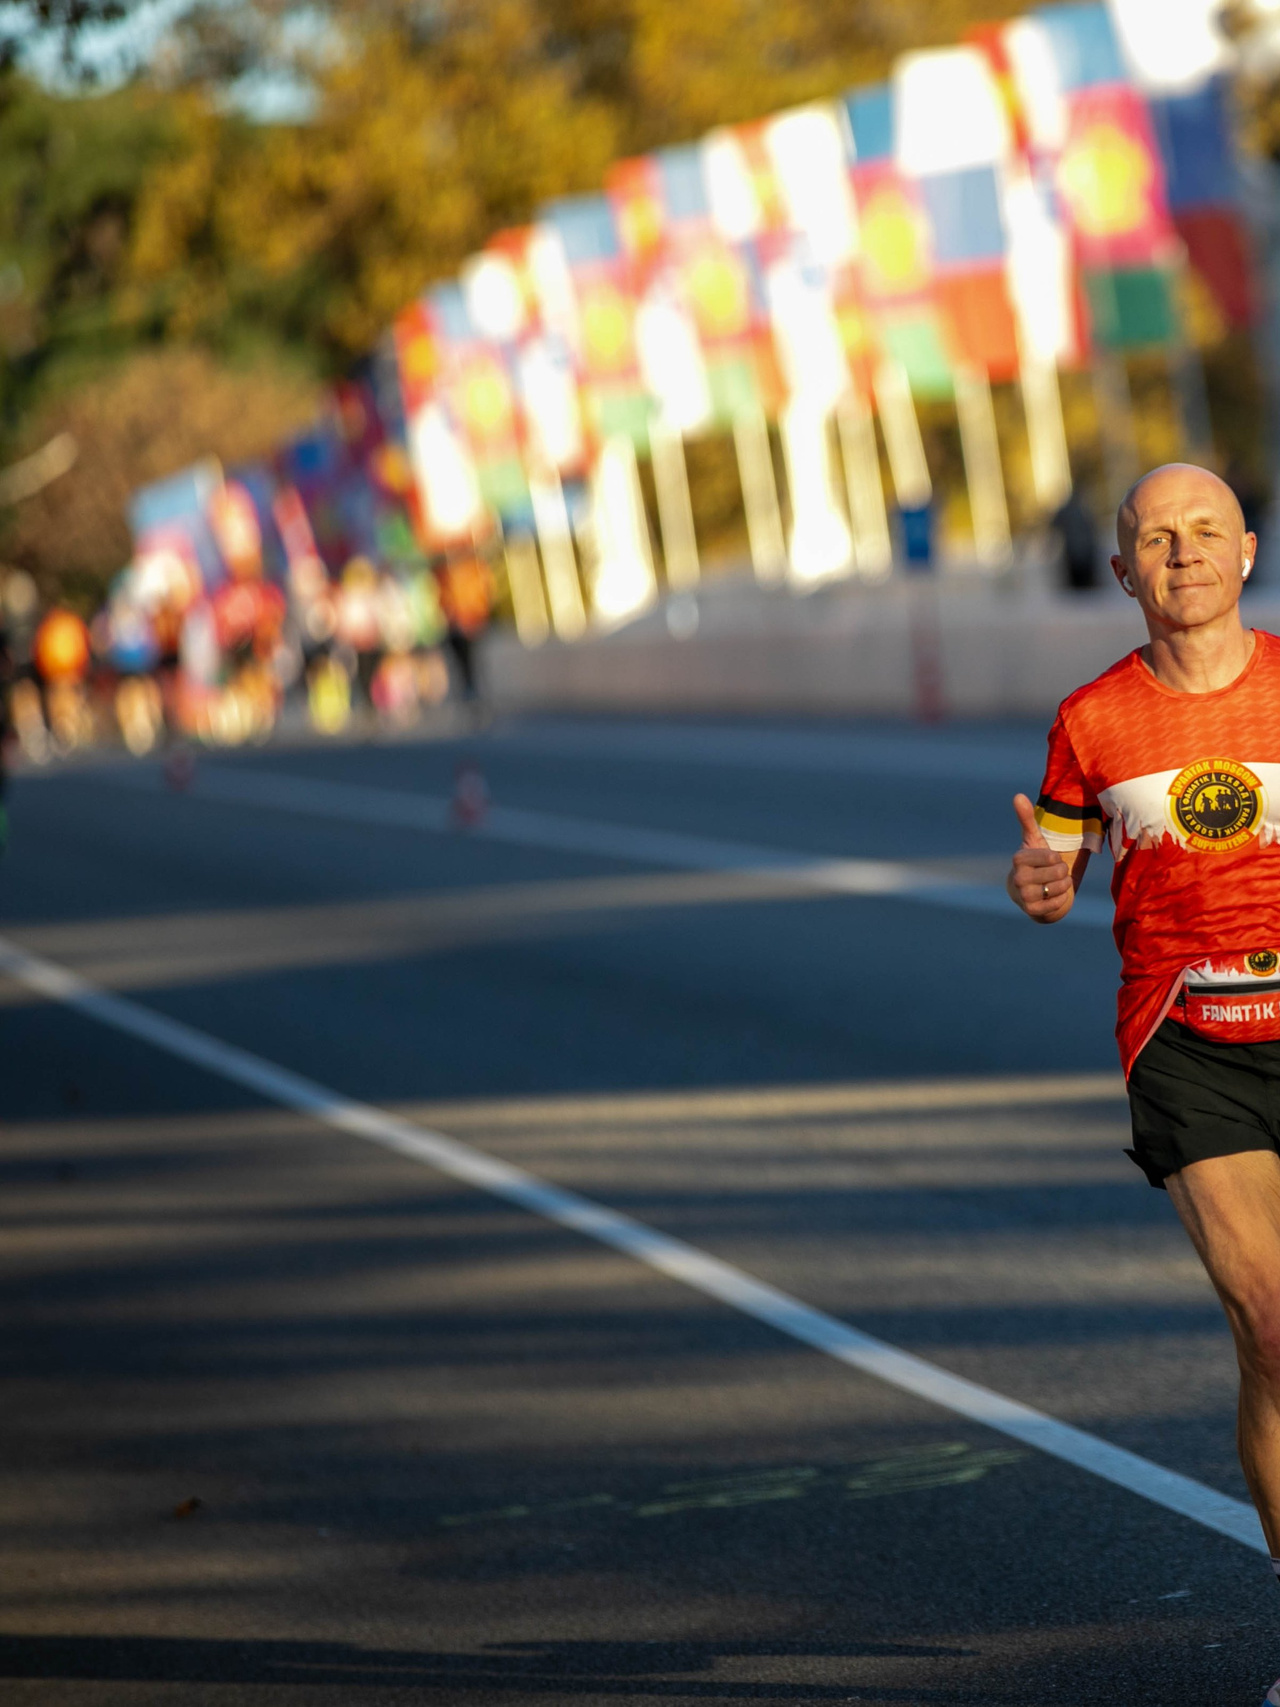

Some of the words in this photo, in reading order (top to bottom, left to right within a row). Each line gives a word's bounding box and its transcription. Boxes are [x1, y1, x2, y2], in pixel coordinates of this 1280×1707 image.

[1171, 761, 1211, 795] SPARTAK
[1213, 760, 1258, 787] MOSCOW
[1185, 814, 1213, 837] SQUAD
[1191, 831, 1250, 851] SUPPORTERS
